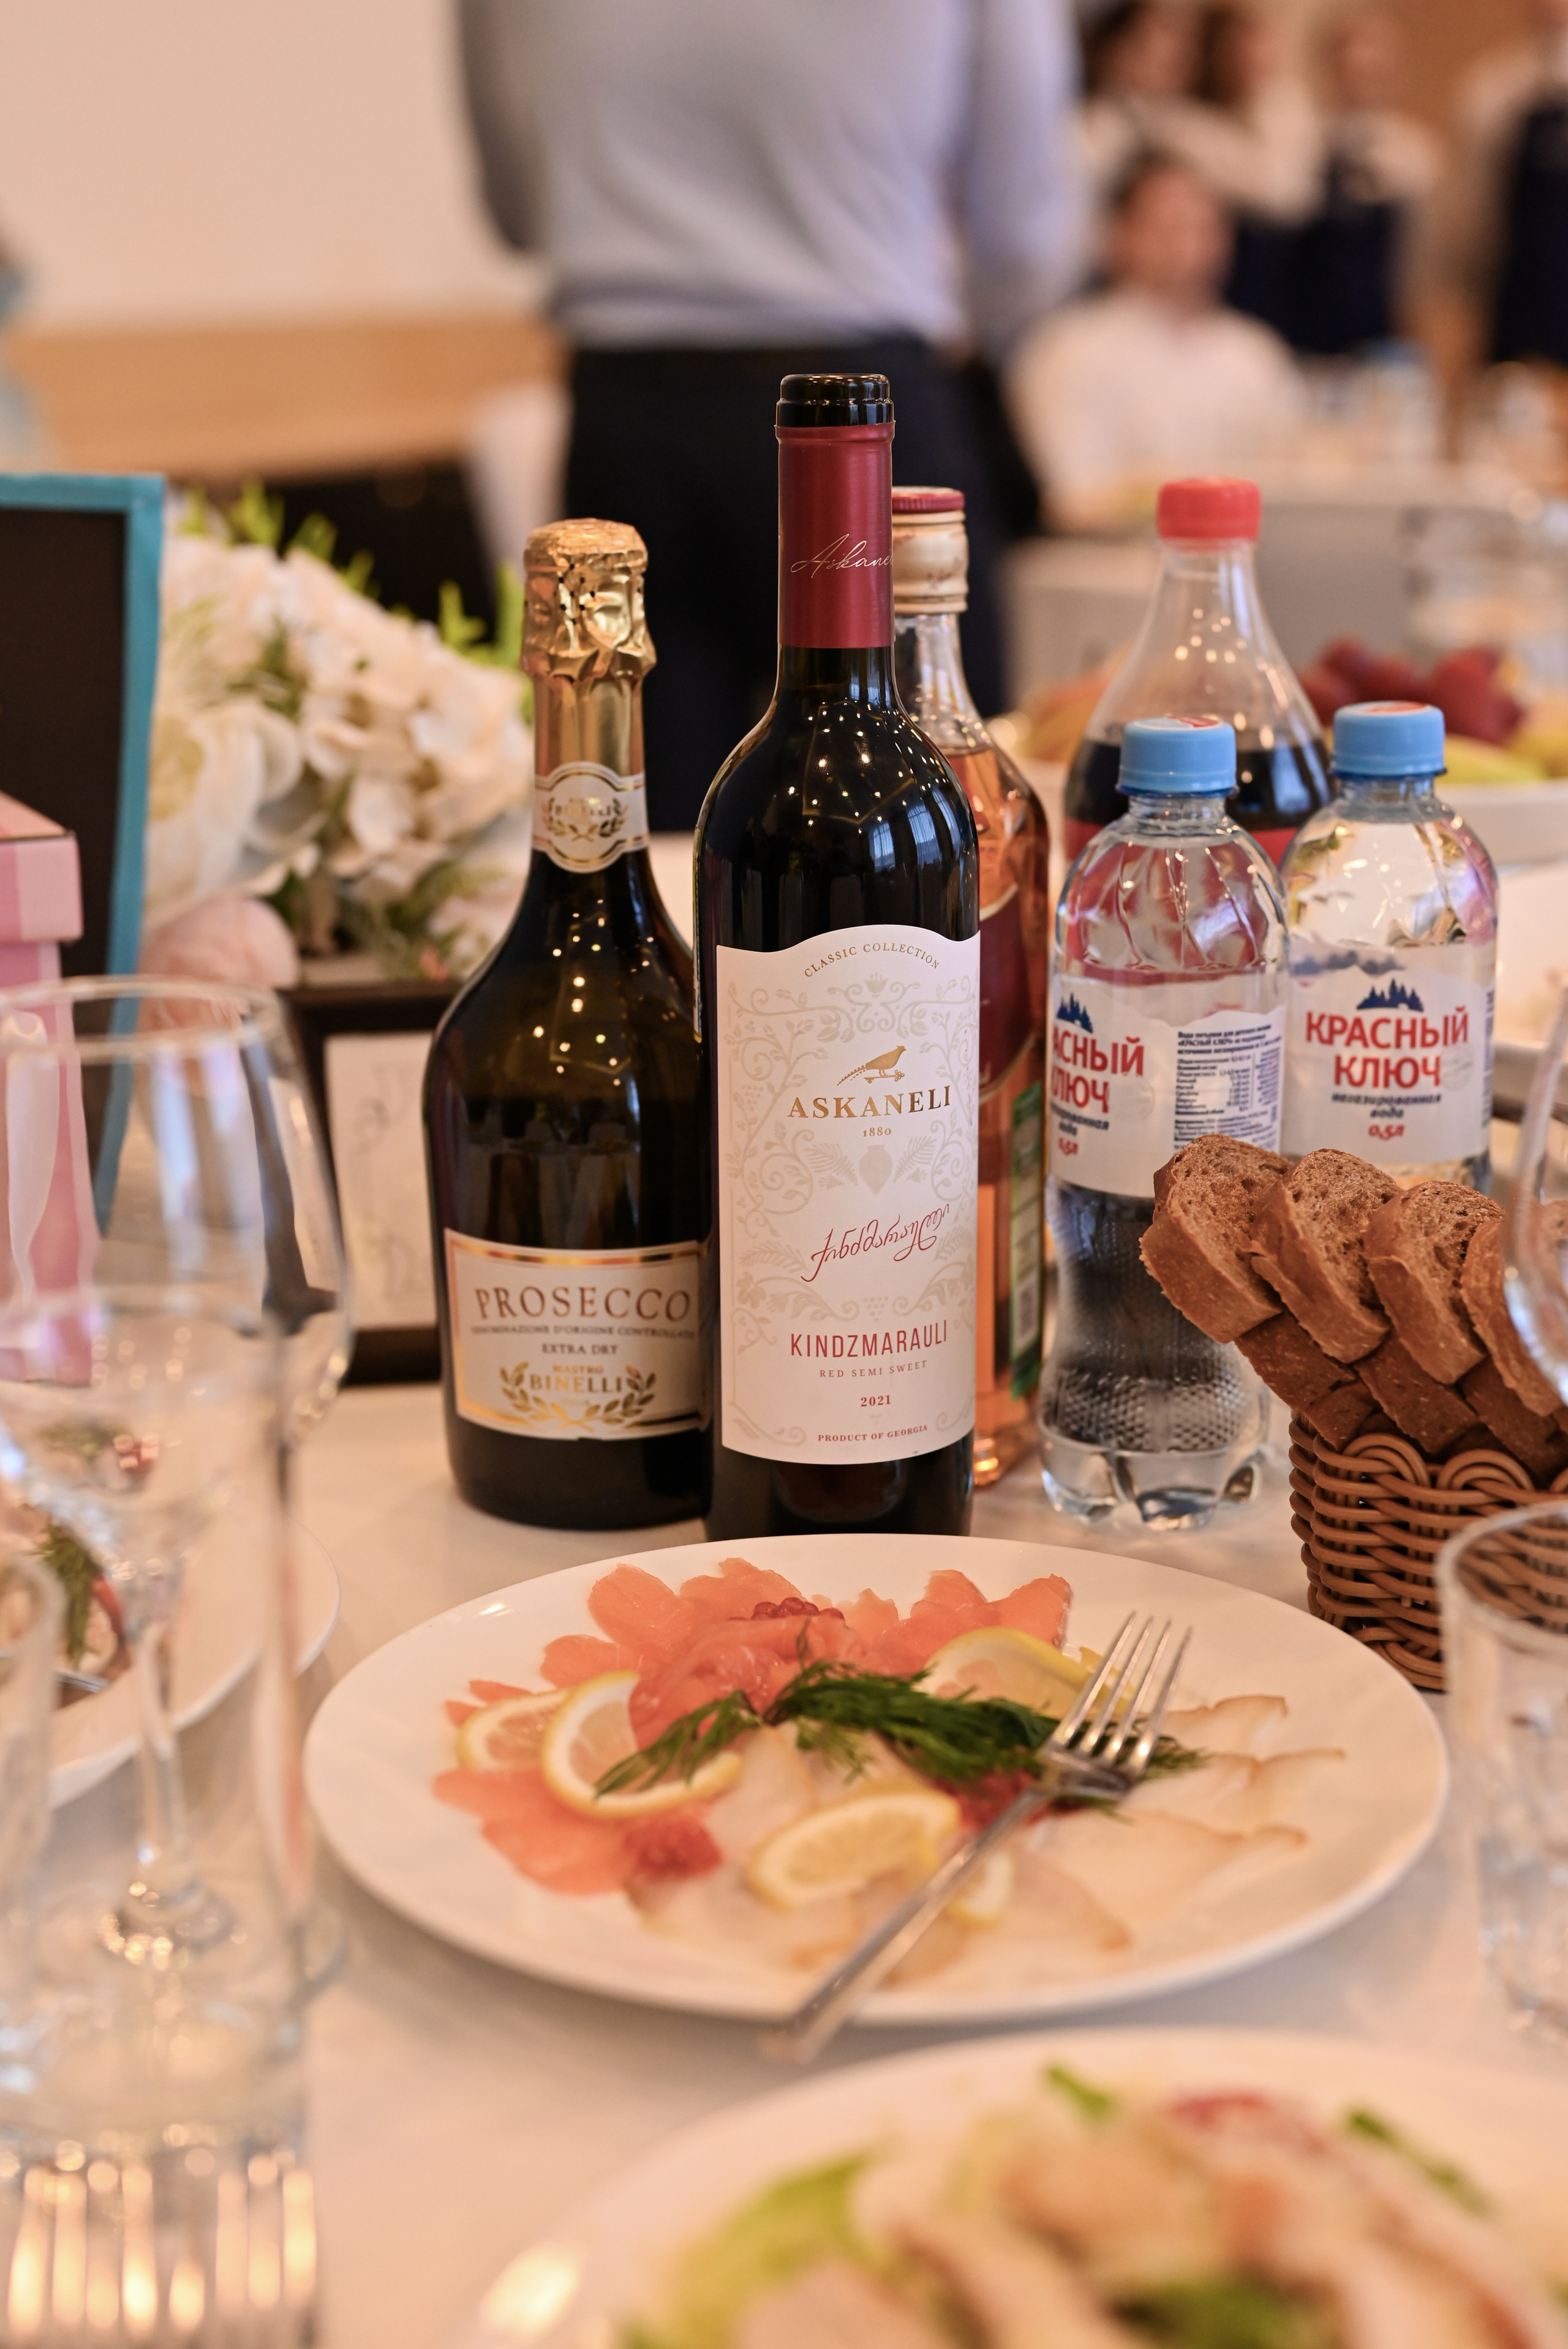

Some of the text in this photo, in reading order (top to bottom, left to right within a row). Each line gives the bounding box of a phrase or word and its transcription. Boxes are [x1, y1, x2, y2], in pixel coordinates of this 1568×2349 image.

[804, 942, 939, 977] CLASSIC COLLECTION
[1306, 1005, 1468, 1049] КРАСНЫЙ
[1334, 1055, 1441, 1089] КЛЮЧ
[787, 1085, 951, 1119] ASKANELI
[862, 1126, 891, 1138] 1880
[475, 1286, 691, 1322] PROSECCO
[542, 1344, 618, 1355] EXTRA DRY
[791, 1320, 947, 1358] KINDZMARAULI
[820, 1360, 927, 1378] RED SEMI SWEET
[530, 1373, 622, 1393] BINELLI
[861, 1394, 891, 1407] 2021
[887, 1424, 928, 1438] GEORGIA
